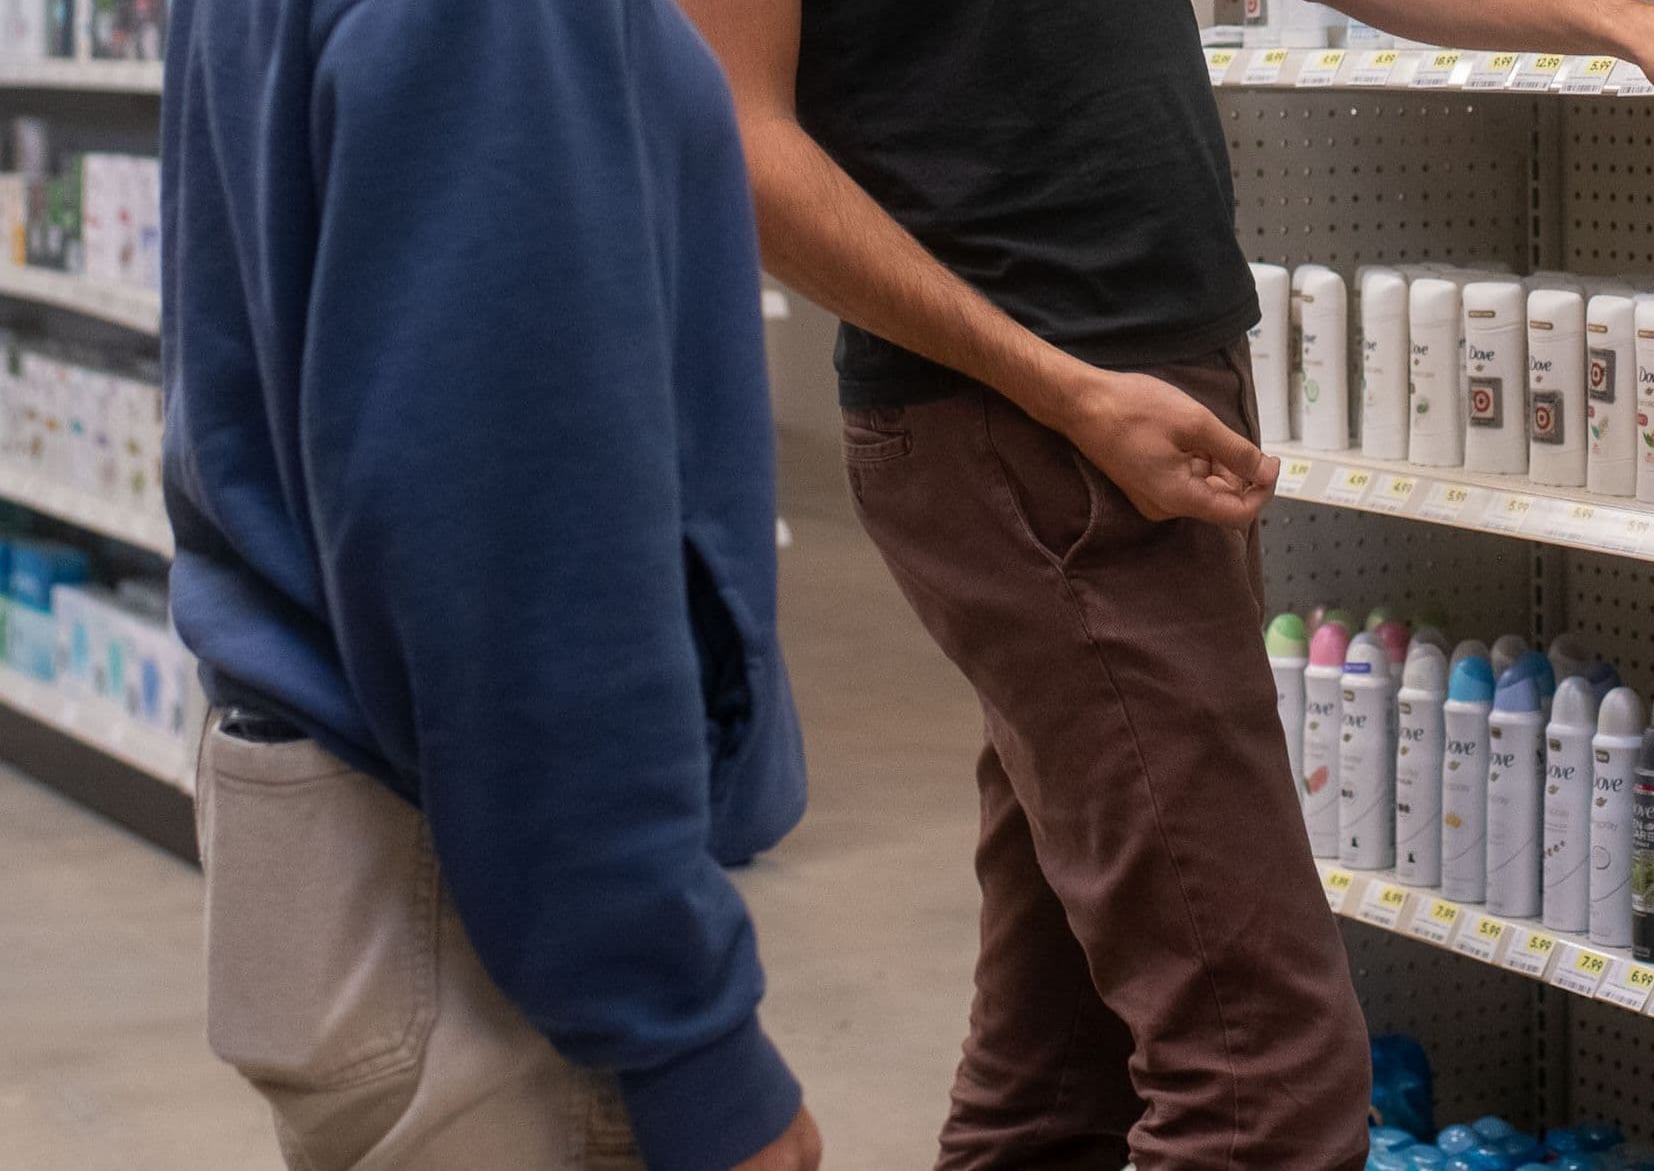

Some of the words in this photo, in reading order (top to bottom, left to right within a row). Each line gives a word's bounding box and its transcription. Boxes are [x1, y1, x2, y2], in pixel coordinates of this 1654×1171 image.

[1494, 56, 1513, 68] 9.99
[1536, 57, 1560, 69] 12.99
[1590, 59, 1612, 72] 5.99
[1469, 344, 1495, 362] Dove
[1530, 355, 1552, 372] Dove
[1401, 728, 1424, 742] ove
[1491, 753, 1515, 768] ove
[1550, 765, 1575, 780] ove
[1529, 936, 1552, 950] 5.99
[1581, 956, 1604, 971] 7.99
[1631, 970, 1654, 985] 6.99
